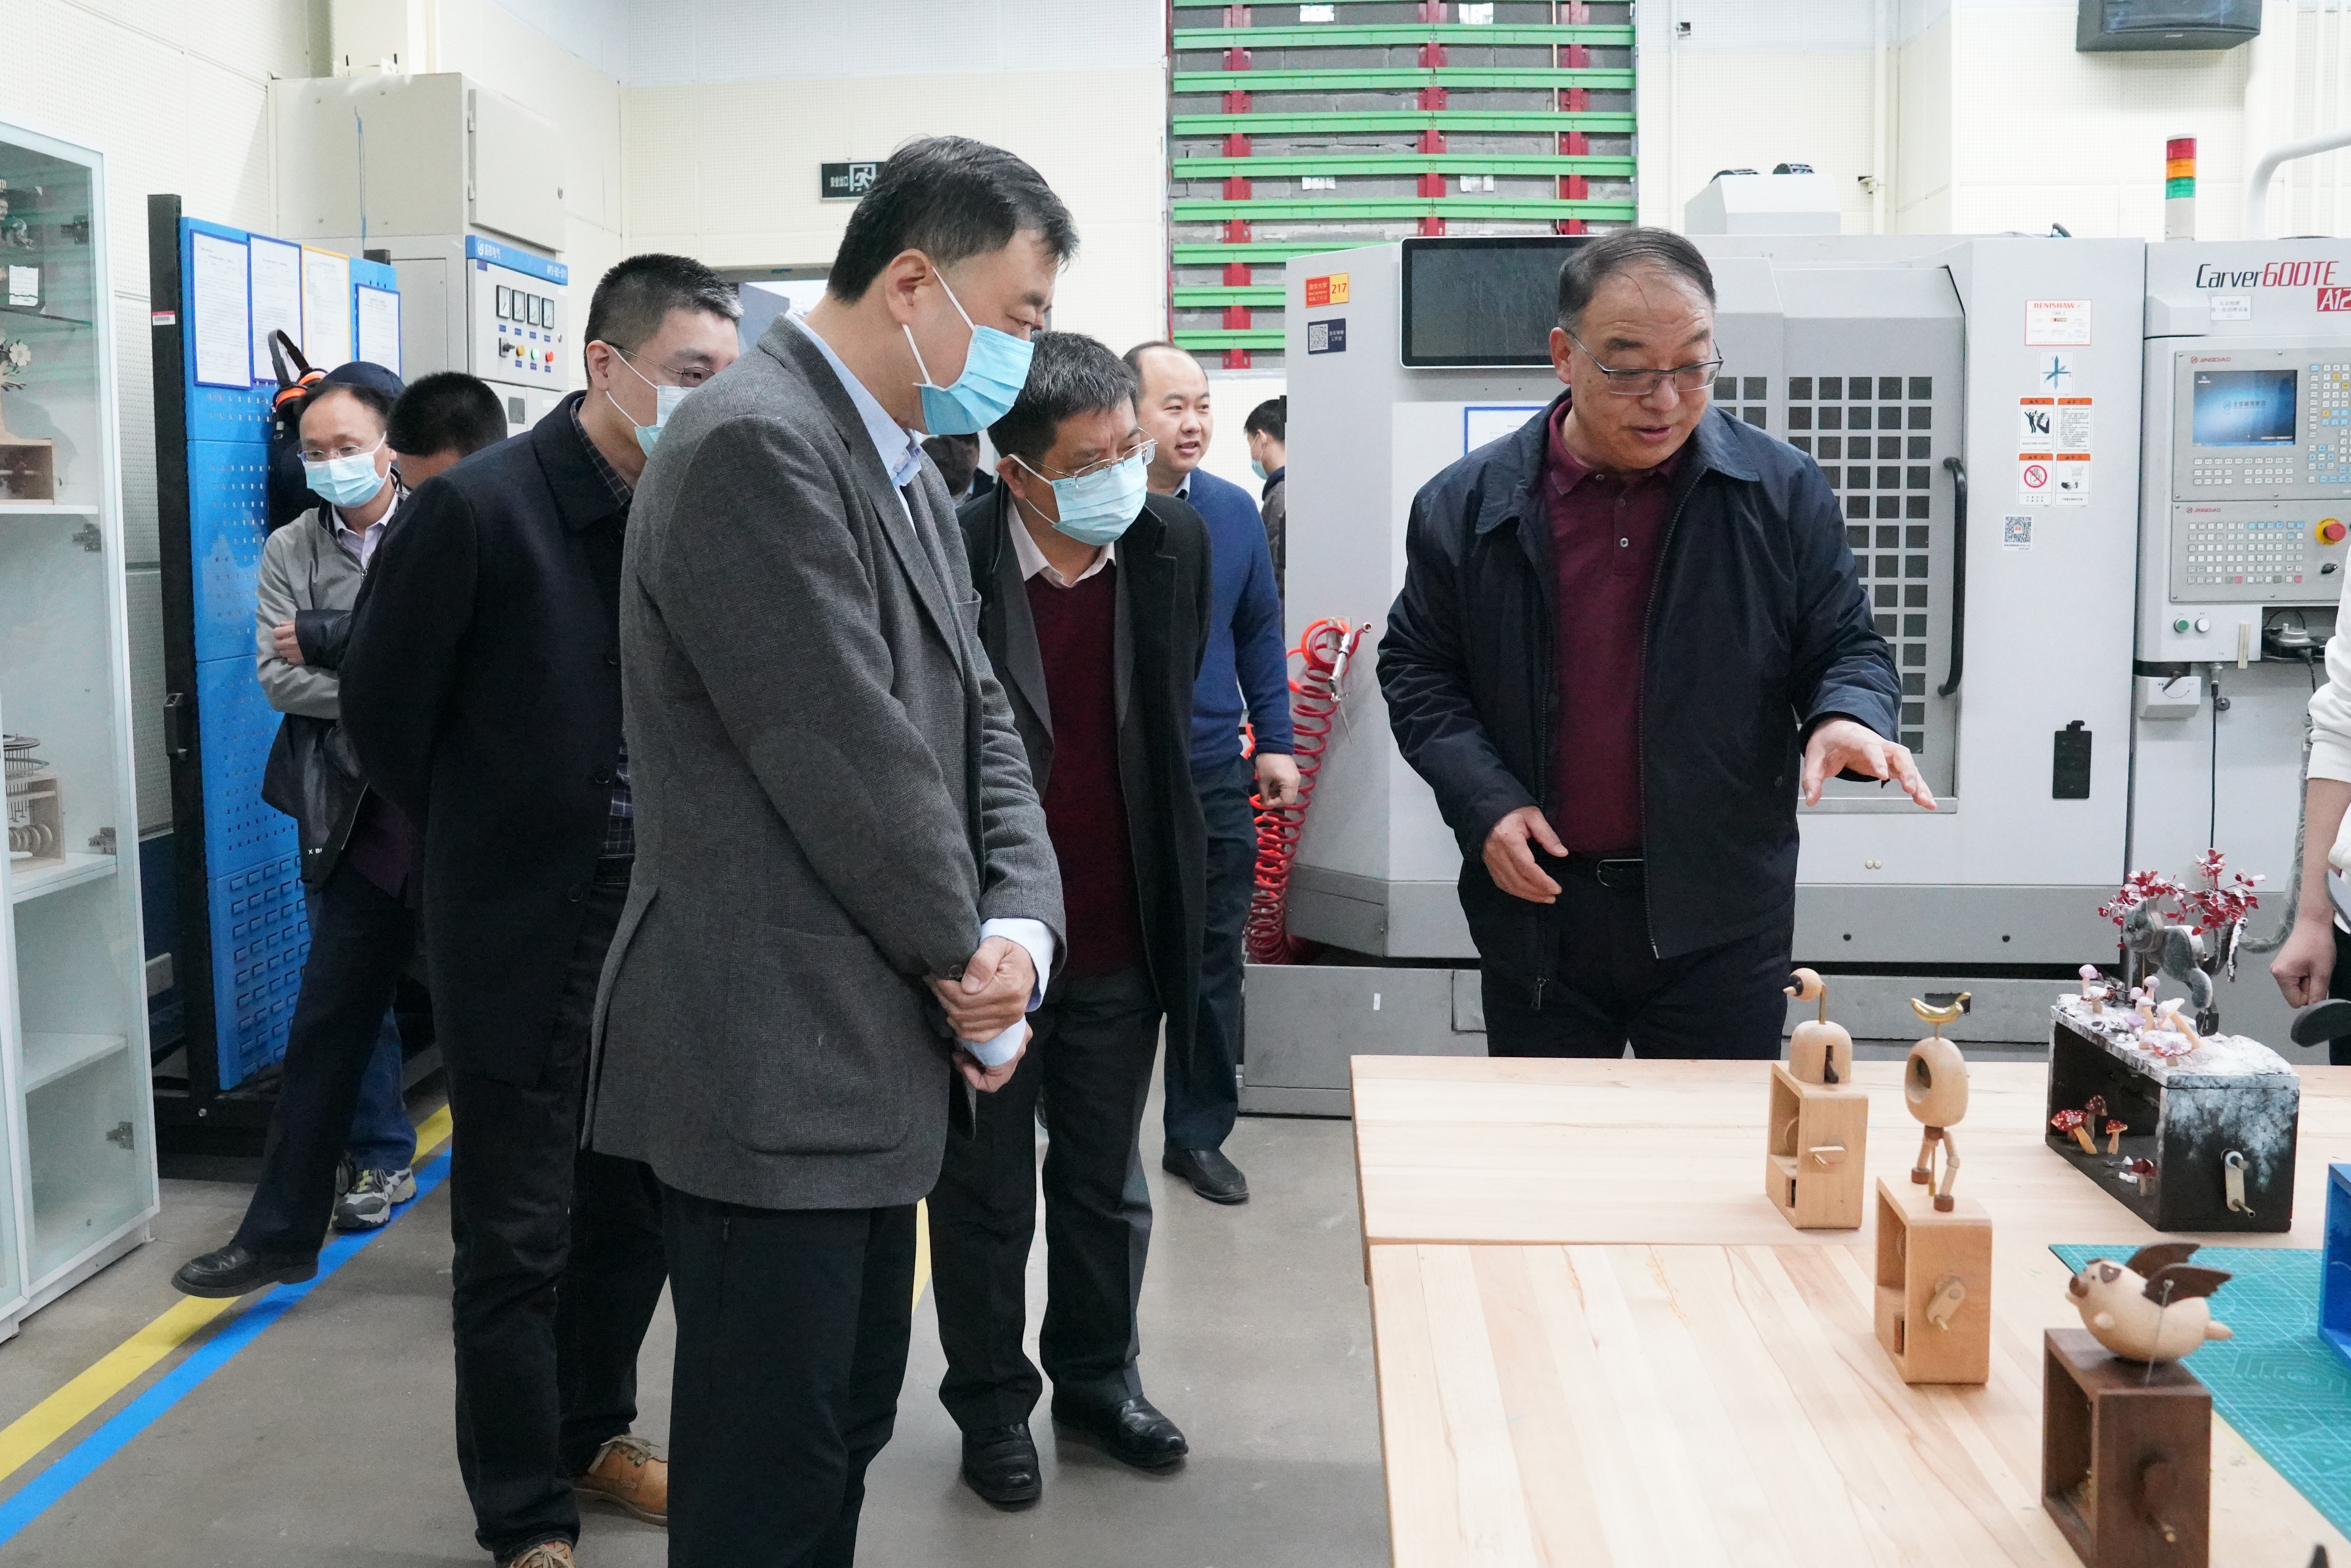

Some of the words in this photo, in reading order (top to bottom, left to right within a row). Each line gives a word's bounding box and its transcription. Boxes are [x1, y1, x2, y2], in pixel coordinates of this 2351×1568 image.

[2196, 261, 2339, 288] Carver600TE
[1308, 282, 1327, 290] 清华大学
[1331, 283, 1347, 294] 217
